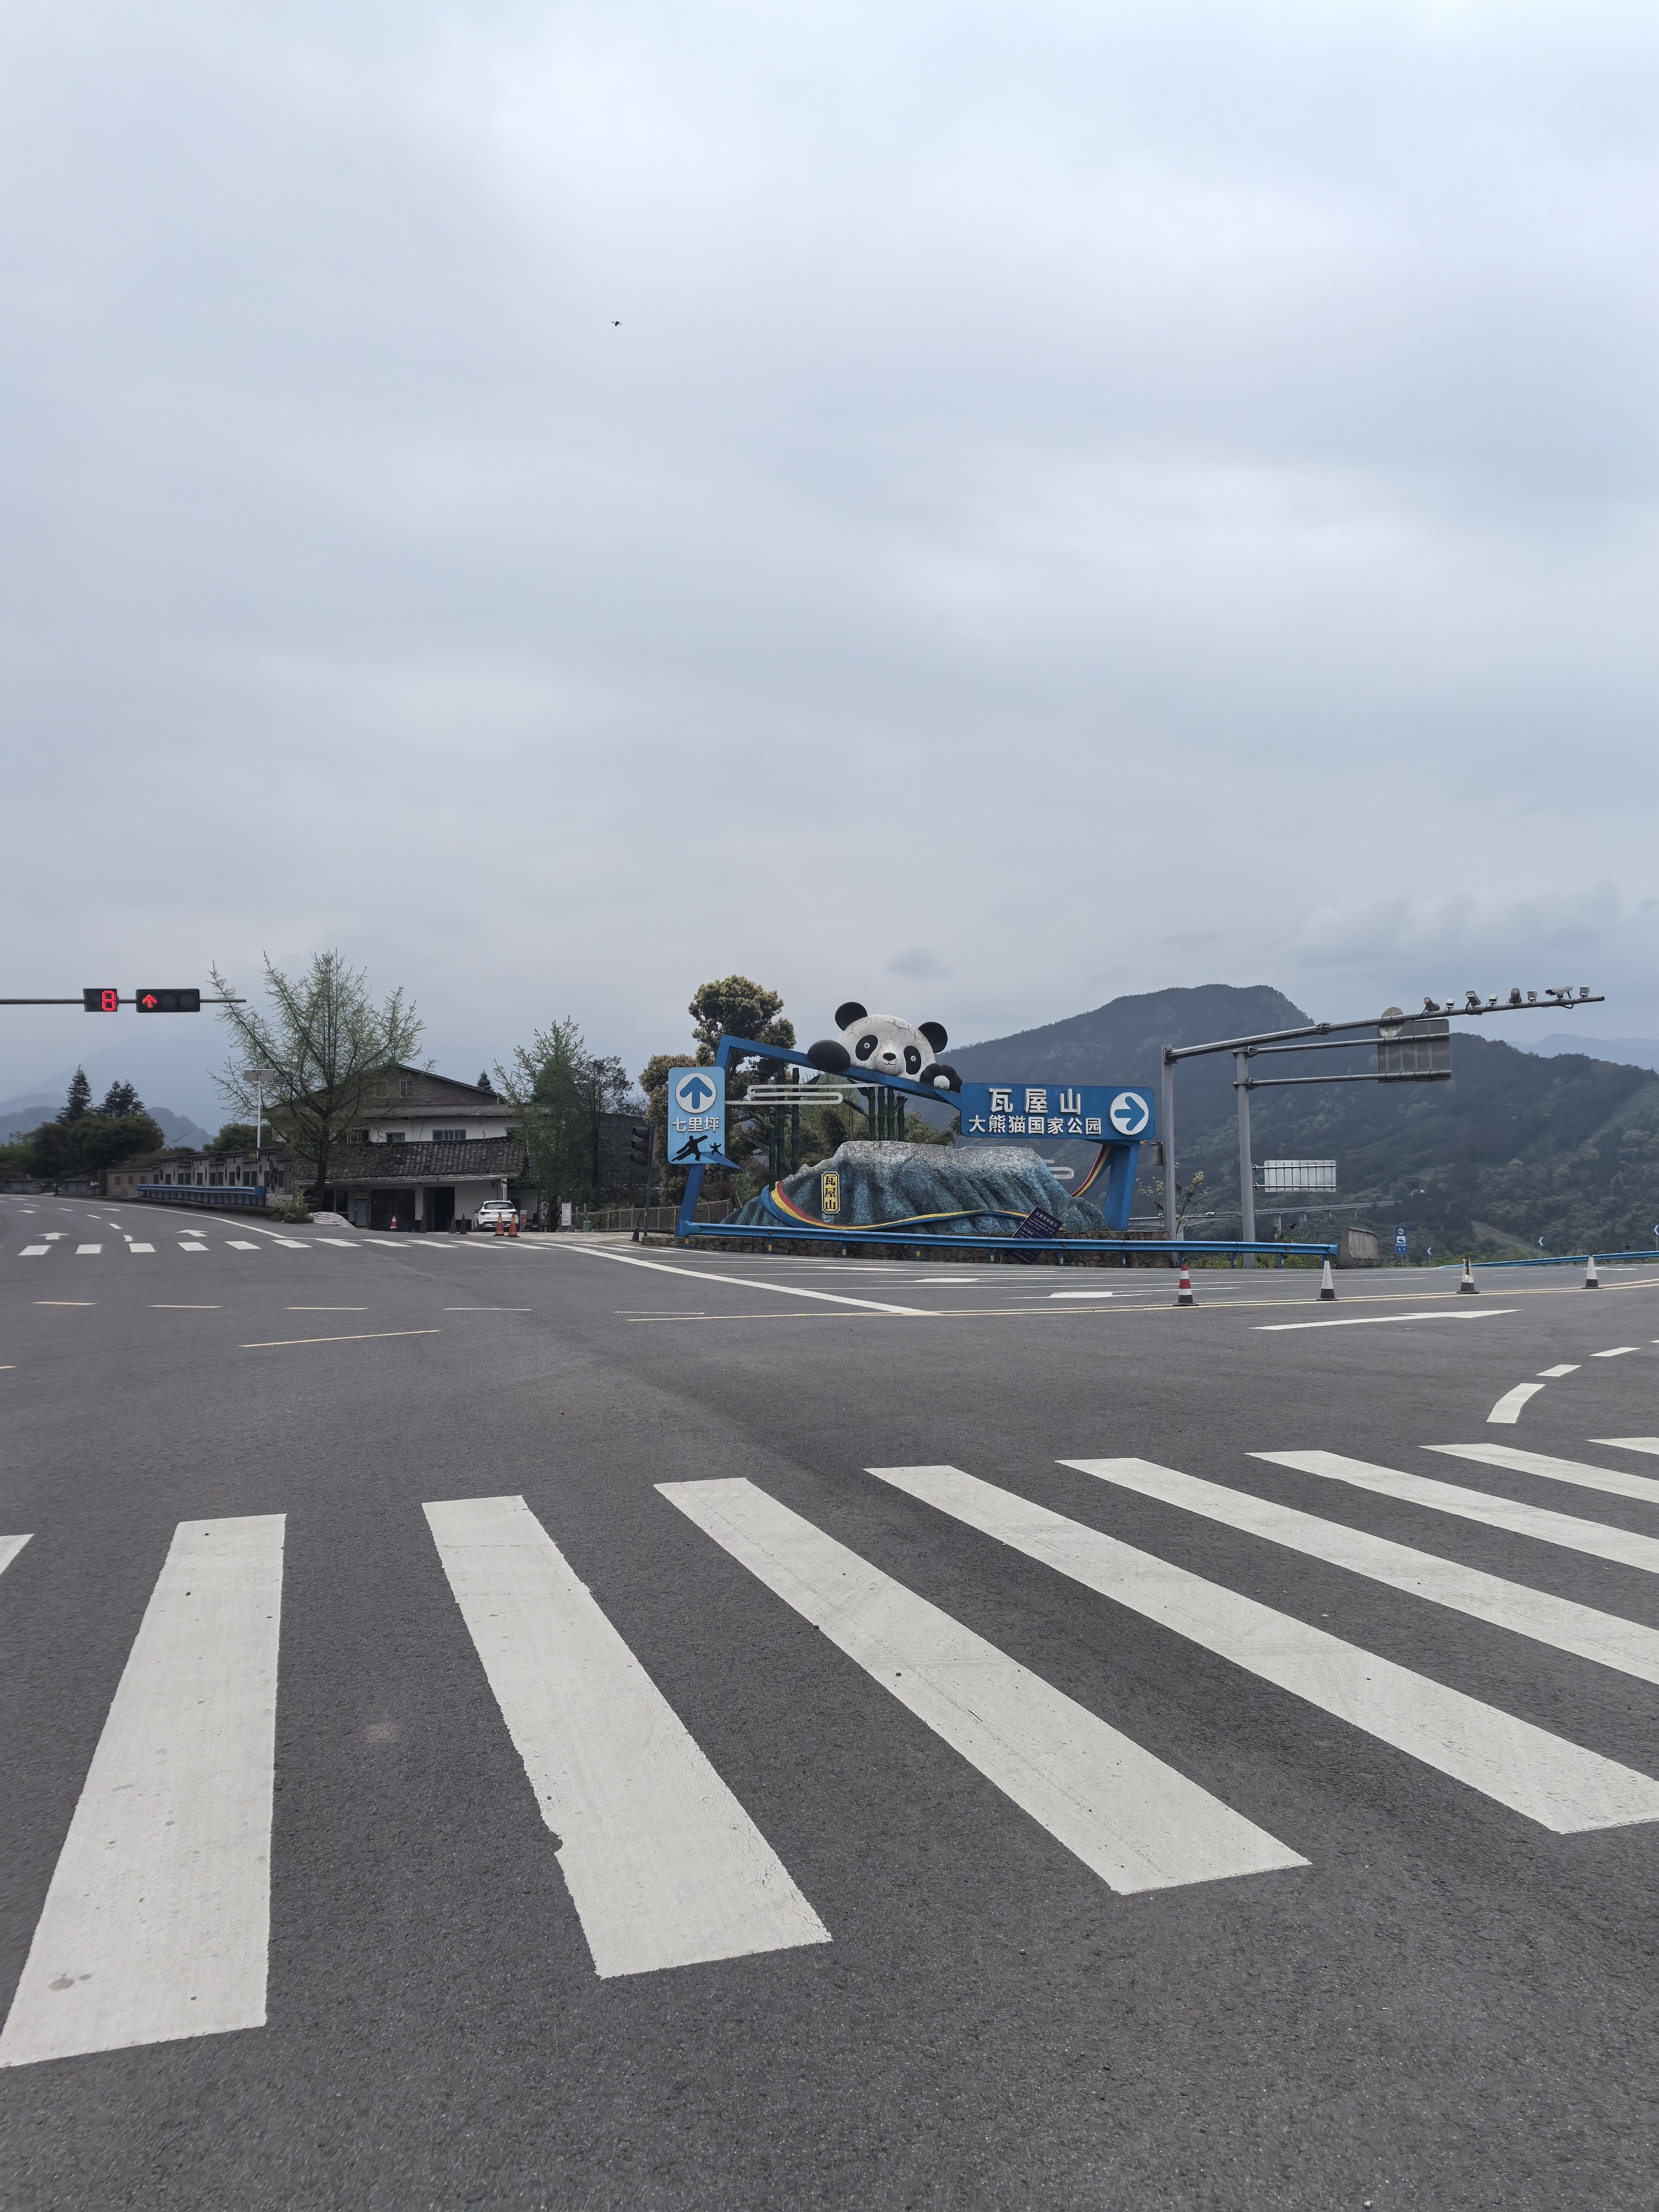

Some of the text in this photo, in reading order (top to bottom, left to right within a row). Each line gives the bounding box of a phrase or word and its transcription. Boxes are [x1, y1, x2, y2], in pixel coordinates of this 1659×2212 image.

[102, 990, 115, 1011] 8
[988, 1088, 1081, 1115] 瓦屋山
[671, 1116, 719, 1132] 七里坪
[968, 1114, 1101, 1135] 大熊猫国家公园
[824, 1175, 837, 1210] 瓦屋山
